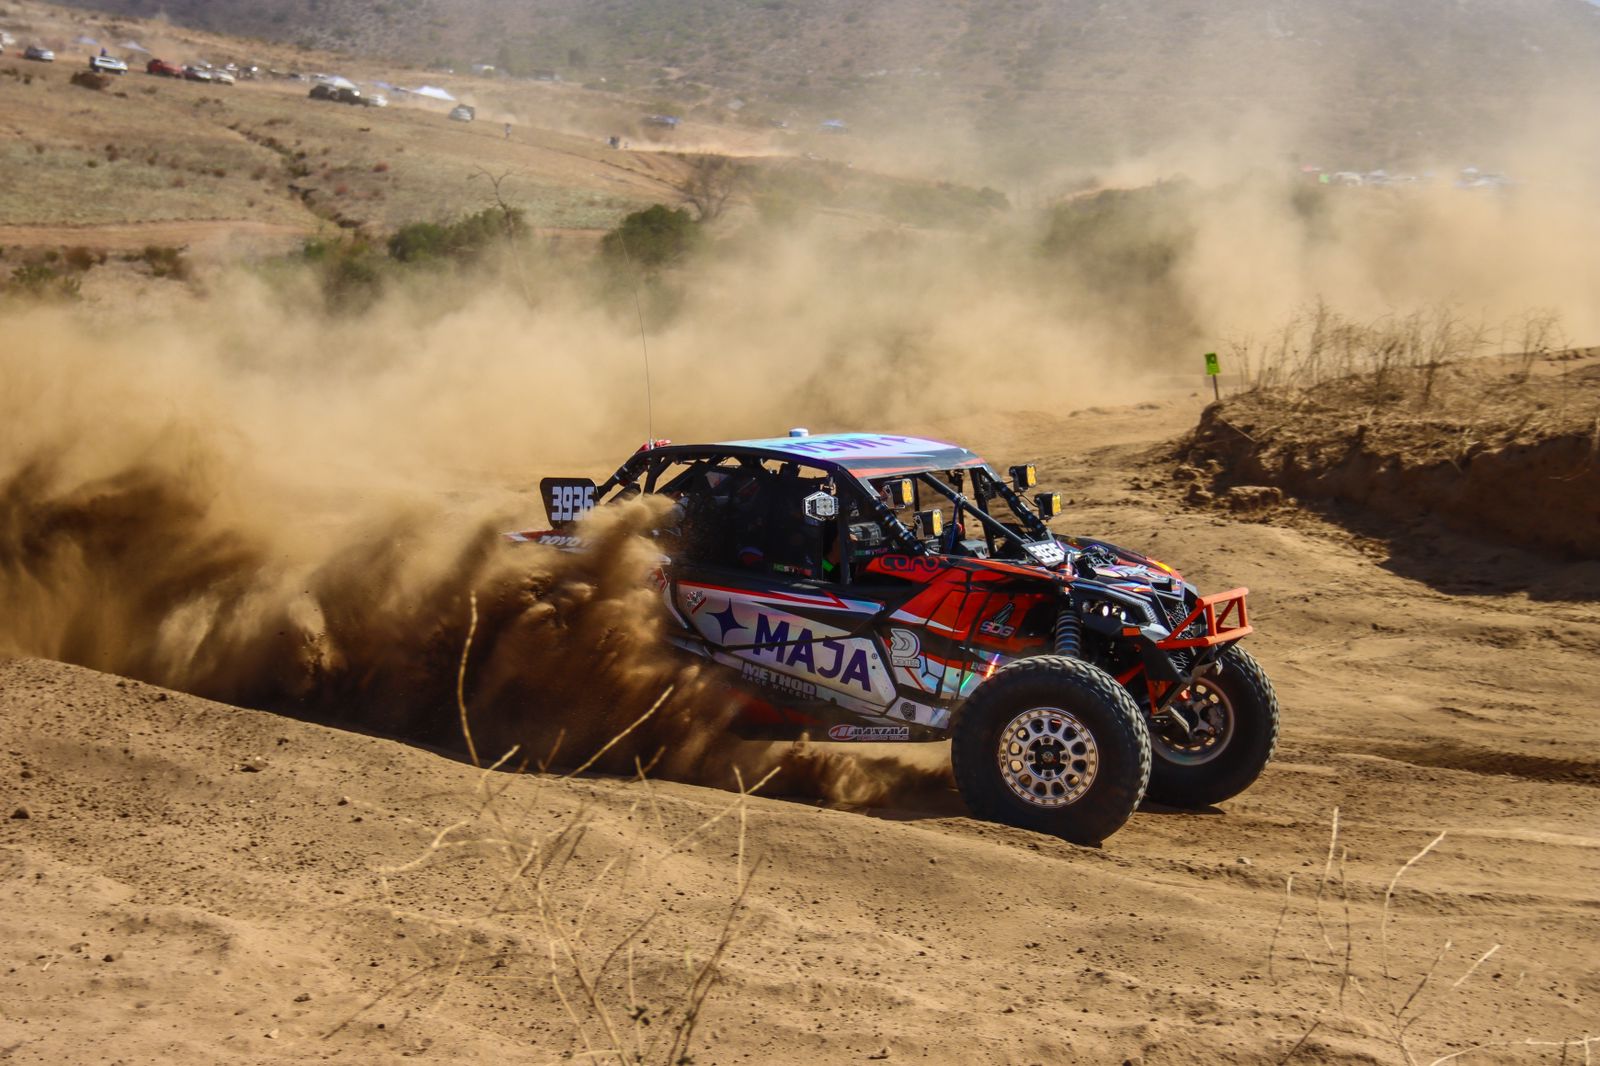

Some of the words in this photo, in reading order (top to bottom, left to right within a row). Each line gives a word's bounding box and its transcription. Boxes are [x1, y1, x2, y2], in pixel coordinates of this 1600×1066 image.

[551, 486, 594, 521] 3936
[752, 612, 872, 692] MAJA
[742, 662, 817, 696] METHOD
